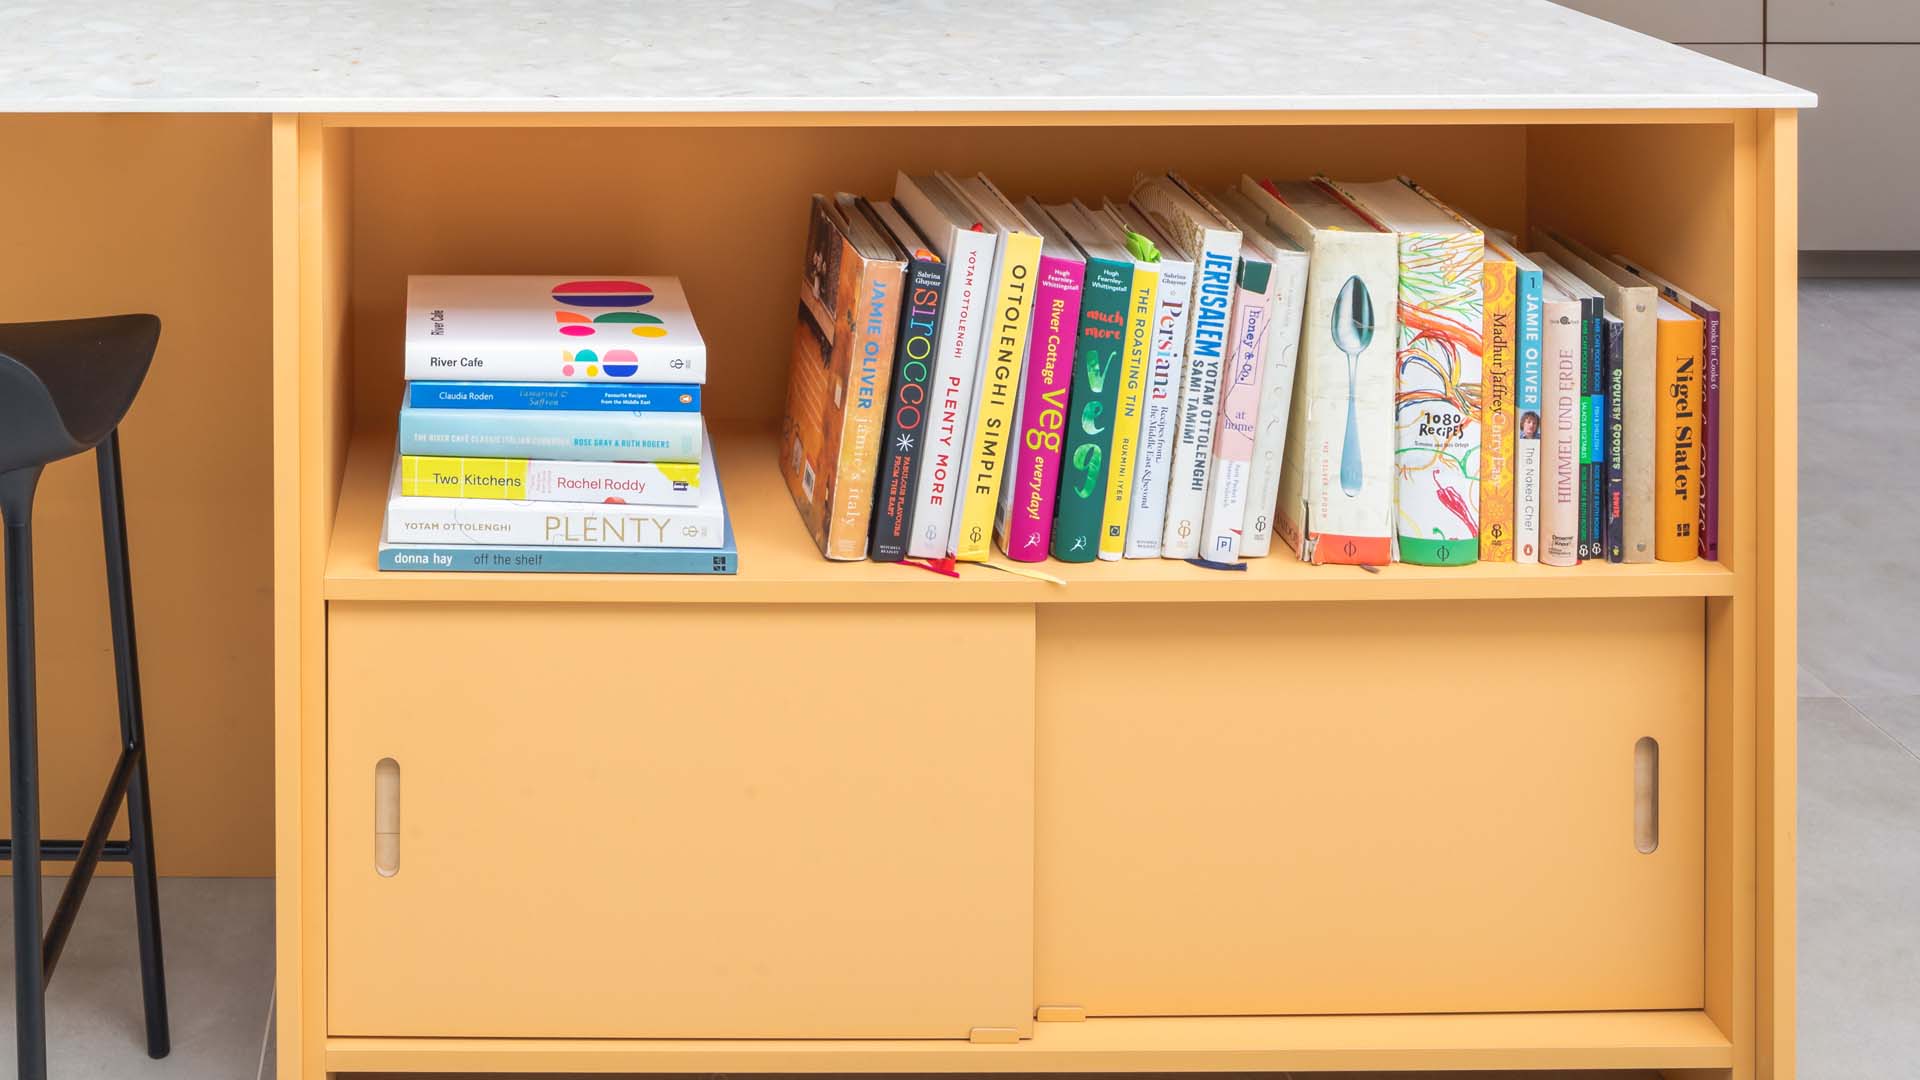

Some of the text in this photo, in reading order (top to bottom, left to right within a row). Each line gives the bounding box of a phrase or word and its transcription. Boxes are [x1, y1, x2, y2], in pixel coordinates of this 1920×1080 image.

[915, 277, 941, 287] Ghayour
[917, 271, 941, 280] Sabrina
[1054, 269, 1071, 277] Hugh
[1103, 268, 1120, 277] Hugh
[1530, 277, 1536, 289] 1
[954, 251, 977, 358] YOTAM OTTOLENGHI
[1086, 308, 1124, 326] much
[1194, 251, 1233, 358] JERUSALEM
[858, 280, 887, 409] JAMIE OLIVER
[1041, 299, 1065, 385] River Cottage
[1085, 327, 1121, 340] more
[1711, 320, 1719, 343] Books
[430, 356, 484, 368] River Cafe
[1124, 288, 1150, 417] THE ROASTING TIN
[1152, 299, 1182, 400] Persiana
[1524, 294, 1539, 404] JAMIE OLIVER
[1711, 344, 1719, 356] for
[1490, 313, 1508, 415] Madhur Jaffrey
[1711, 358, 1719, 382] Cooks
[976, 264, 1027, 495] OTTOLENGHI SIMPLE
[439, 391, 494, 401] Claudia Roden
[1183, 360, 1204, 445] SAMI TAMIMI
[1158, 406, 1169, 434] Recipes
[1191, 362, 1220, 491] YOTAM OTTOLENGHI
[1224, 419, 1254, 433] home
[1235, 410, 1245, 420] at
[1424, 412, 1461, 426] 1080
[1558, 349, 1574, 504] HIMMEL UND ERDE
[1611, 369, 1622, 469] GHOULISH GOODIES
[1669, 357, 1694, 500] Nigel Slater
[574, 438, 591, 448] ROSE
[593, 438, 612, 448] GRAY
[613, 439, 620, 448] &
[621, 439, 641, 448] RUTH
[643, 439, 670, 449] ROGERS
[930, 376, 961, 506] PLENTY MORE
[1147, 417, 1158, 447] Middle
[1119, 438, 1130, 477] RUKMINI
[1145, 448, 1154, 467] East
[1489, 413, 1506, 486] Curry Easy
[432, 473, 459, 485] Two
[464, 474, 521, 487] Kitchens
[557, 476, 601, 490] Rachel
[604, 479, 646, 493] Roddy
[840, 417, 873, 527] jamie's italy
[899, 456, 911, 495] FABULOUS
[1524, 447, 1535, 532] The Naked Chef
[404, 522, 511, 532] YOTAM OTTOLENGHI
[545, 516, 672, 543] PLENTY
[394, 552, 453, 567] donna hay
[473, 553, 543, 566] off the shelf
